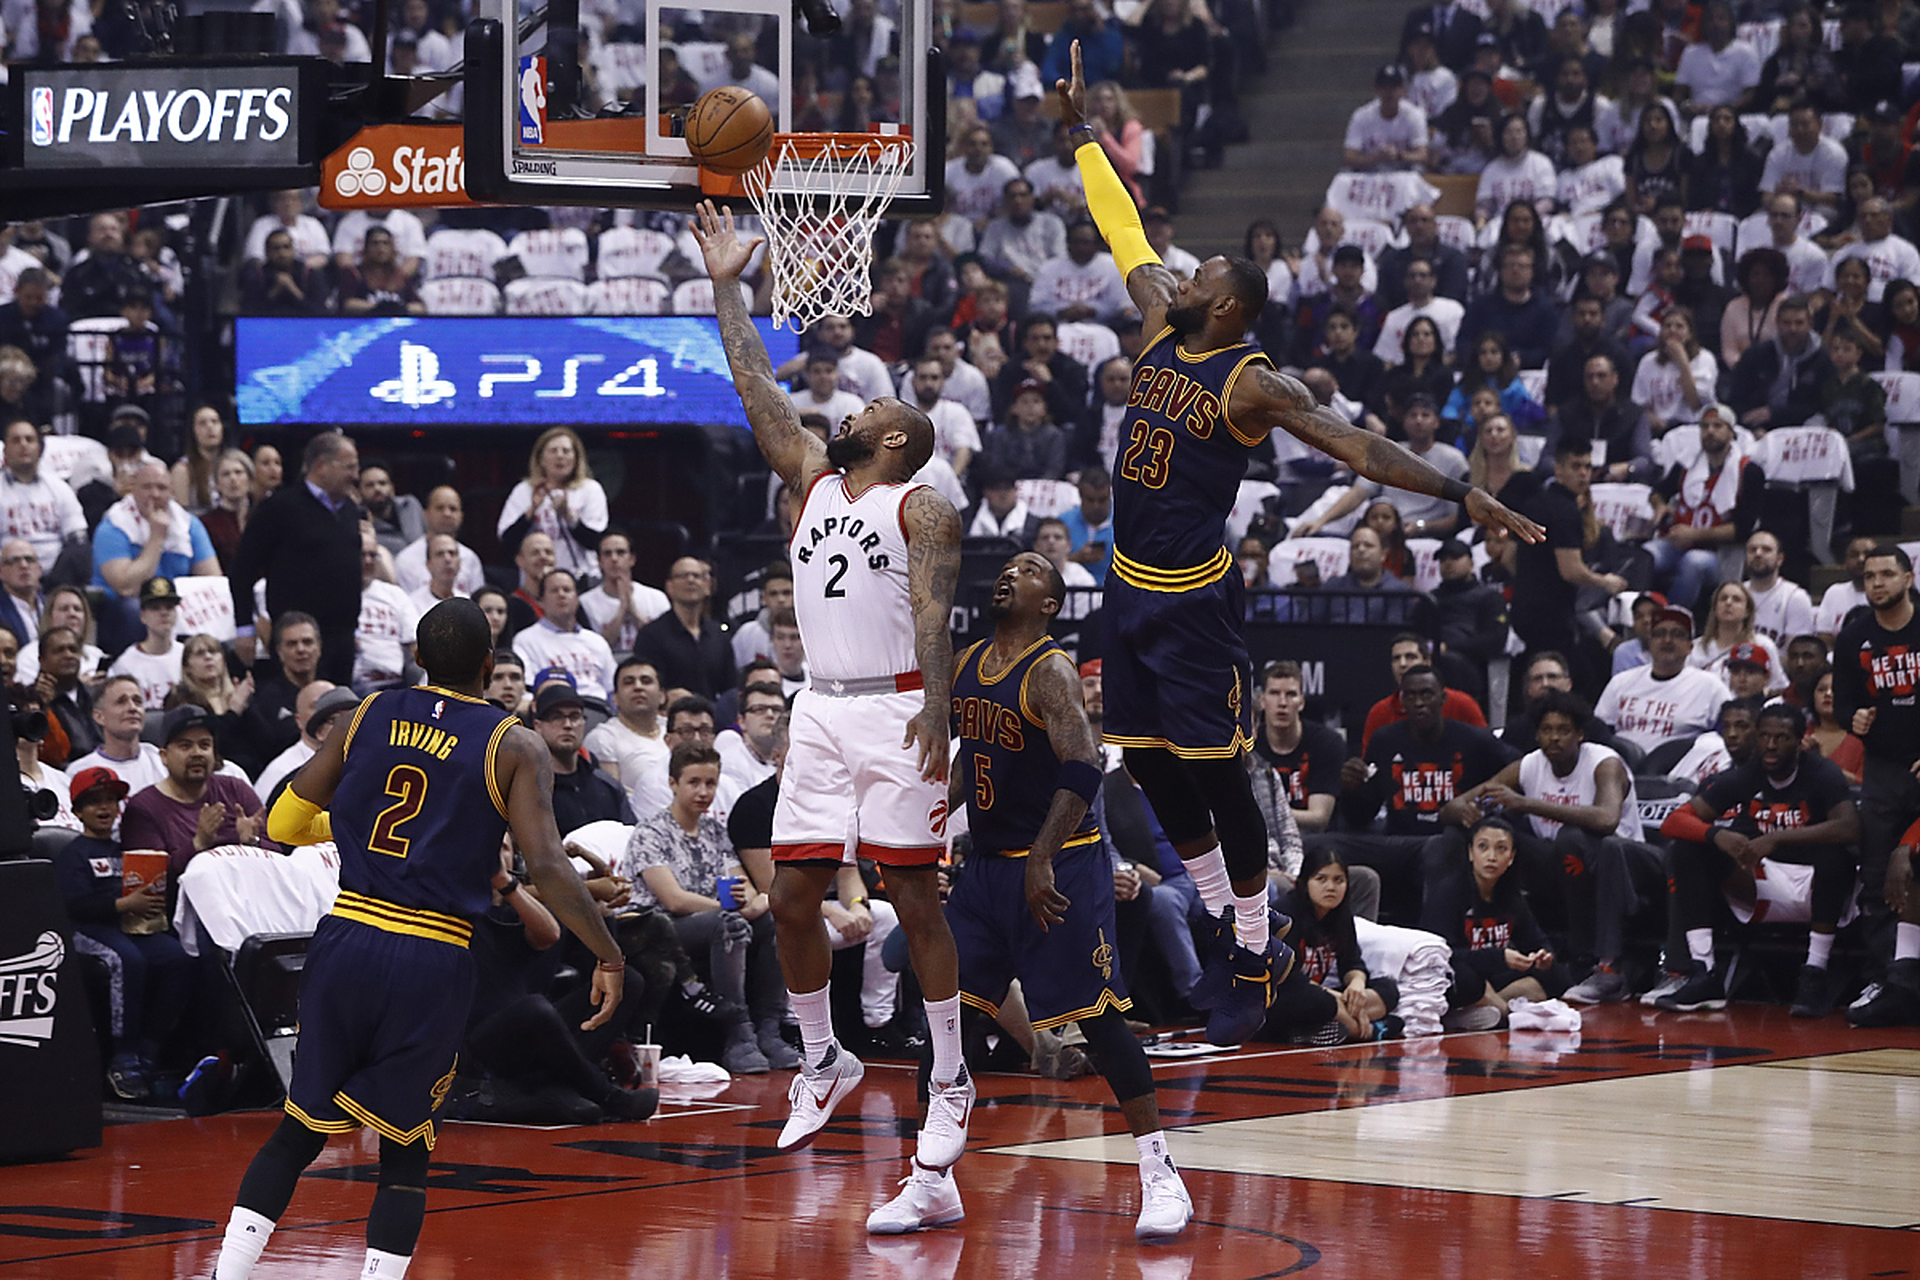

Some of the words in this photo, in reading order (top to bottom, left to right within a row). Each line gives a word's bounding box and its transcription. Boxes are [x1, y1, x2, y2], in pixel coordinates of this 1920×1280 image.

[57, 87, 292, 143] PLAYOFFS
[522, 126, 539, 139] NBA
[390, 146, 464, 194] Stat
[512, 161, 556, 176] SPALDING
[478, 353, 666, 398] PS4
[1127, 366, 1221, 440] CAVS
[1121, 419, 1175, 489] 23
[798, 515, 890, 570] RAPTORS
[824, 553, 849, 598] 2
[1873, 668, 1920, 689] NORT
[1619, 696, 1639, 712] WE
[1645, 700, 1679, 718] THE
[389, 719, 458, 760] IRVING
[974, 753, 994, 810] 5
[1402, 771, 1420, 786] WE
[1424, 770, 1453, 786] THE
[1403, 786, 1454, 802] NORTH
[367, 764, 428, 858] 2
[1776, 810, 1803, 826] THE
[1486, 923, 1509, 941] THE
